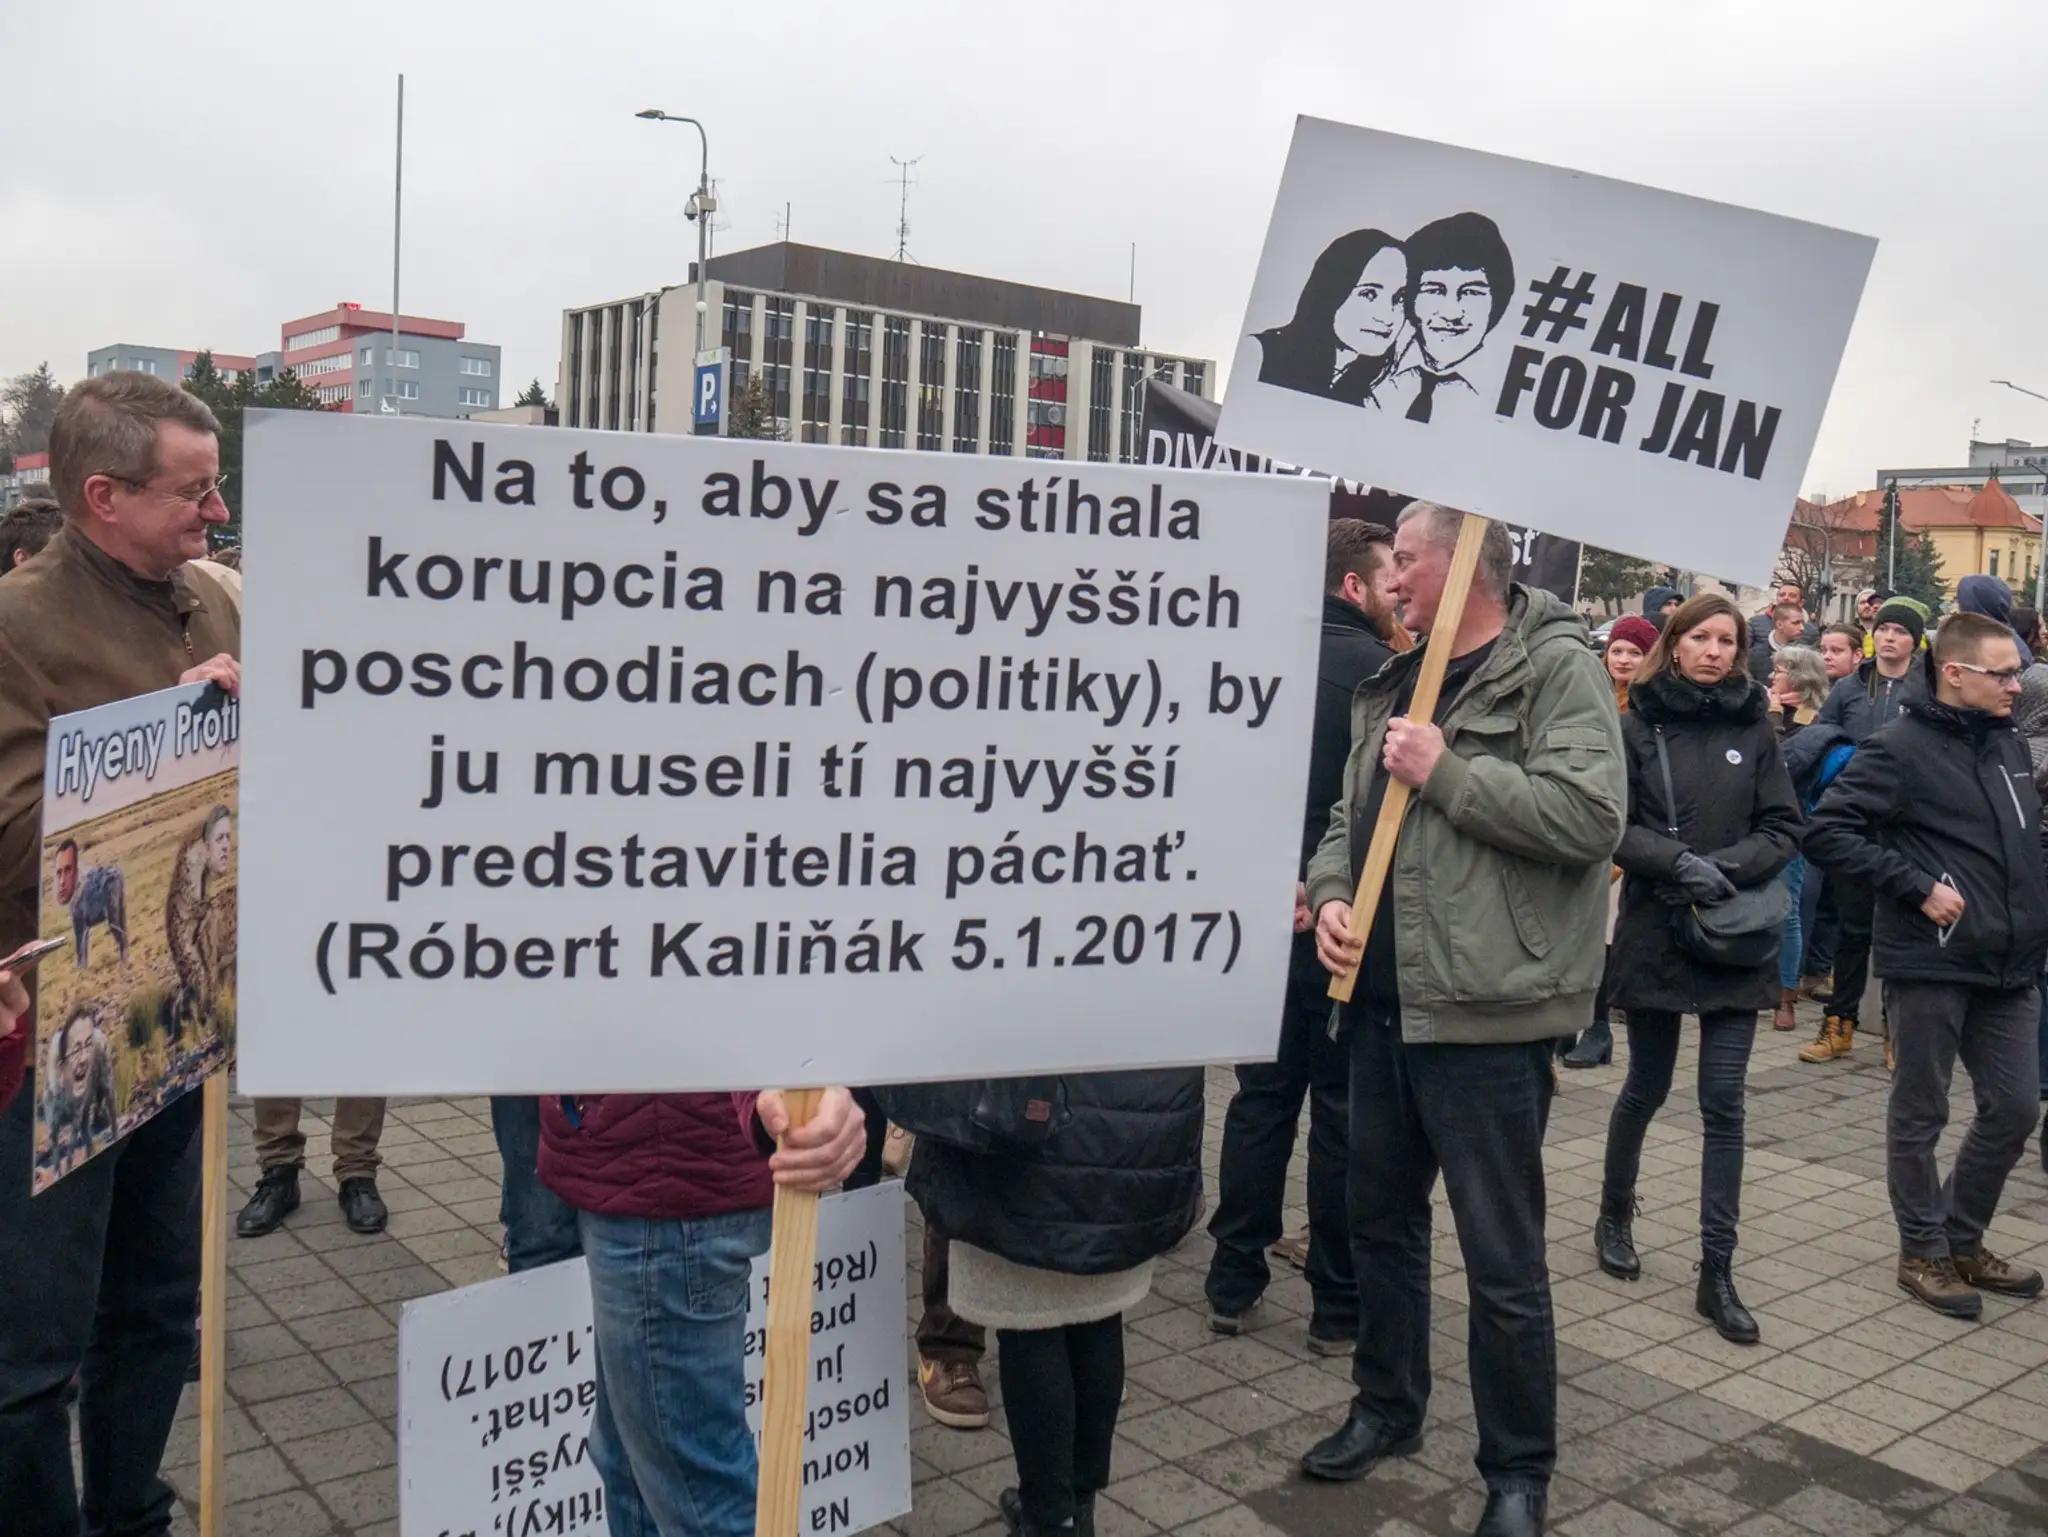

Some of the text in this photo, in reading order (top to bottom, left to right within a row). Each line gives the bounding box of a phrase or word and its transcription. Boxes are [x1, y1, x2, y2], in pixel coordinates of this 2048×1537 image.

[1520, 266, 1720, 380] #ALL
[700, 373, 716, 416] P
[1495, 345, 1783, 481] FOR JAN
[433, 440, 1200, 540] Na to, aby sa stíhala
[367, 535, 1240, 636] korupcia na najvyšších
[301, 640, 1282, 729] poschodiach (politiky), by
[58, 720, 165, 801] Hyeny
[420, 734, 1181, 813] ju museli tí najvyšší
[387, 830, 1197, 902] predstavitelia páchať.
[316, 910, 1242, 995] (Róbert Kaliňák 5.1.2017)
[816, 1344, 845, 1383] ju
[811, 1498, 850, 1532] Na
